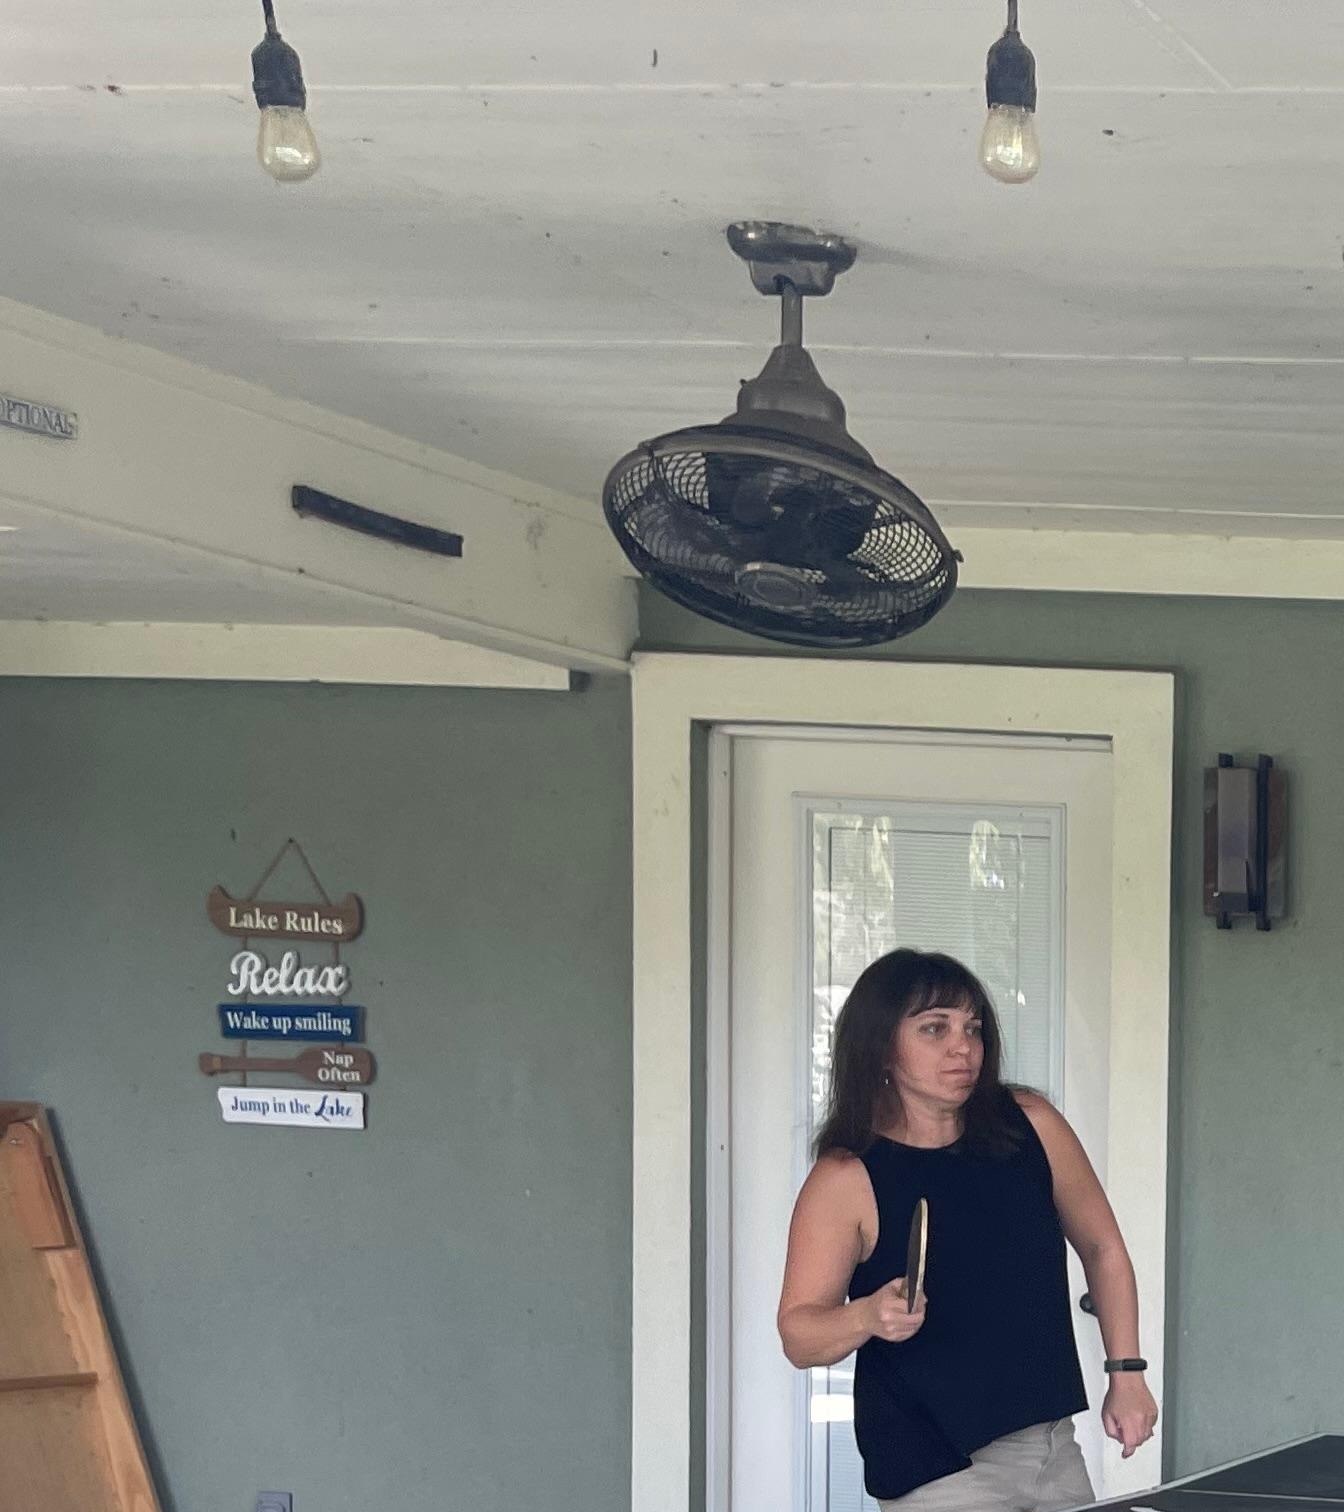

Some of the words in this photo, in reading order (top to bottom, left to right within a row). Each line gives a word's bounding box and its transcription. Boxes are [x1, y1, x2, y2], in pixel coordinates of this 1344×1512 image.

[229, 907, 279, 930] Lake
[285, 911, 344, 935] Rules
[227, 951, 348, 996] Relax
[226, 1010, 270, 1030] Wake
[272, 1016, 293, 1034] up
[294, 1012, 352, 1035] smiling
[322, 1051, 353, 1069] Nap
[317, 1066, 361, 1083] Often
[231, 1096, 270, 1116] Jump
[273, 1097, 287, 1114] in
[290, 1099, 311, 1115] the
[314, 1094, 352, 1122] Lake
